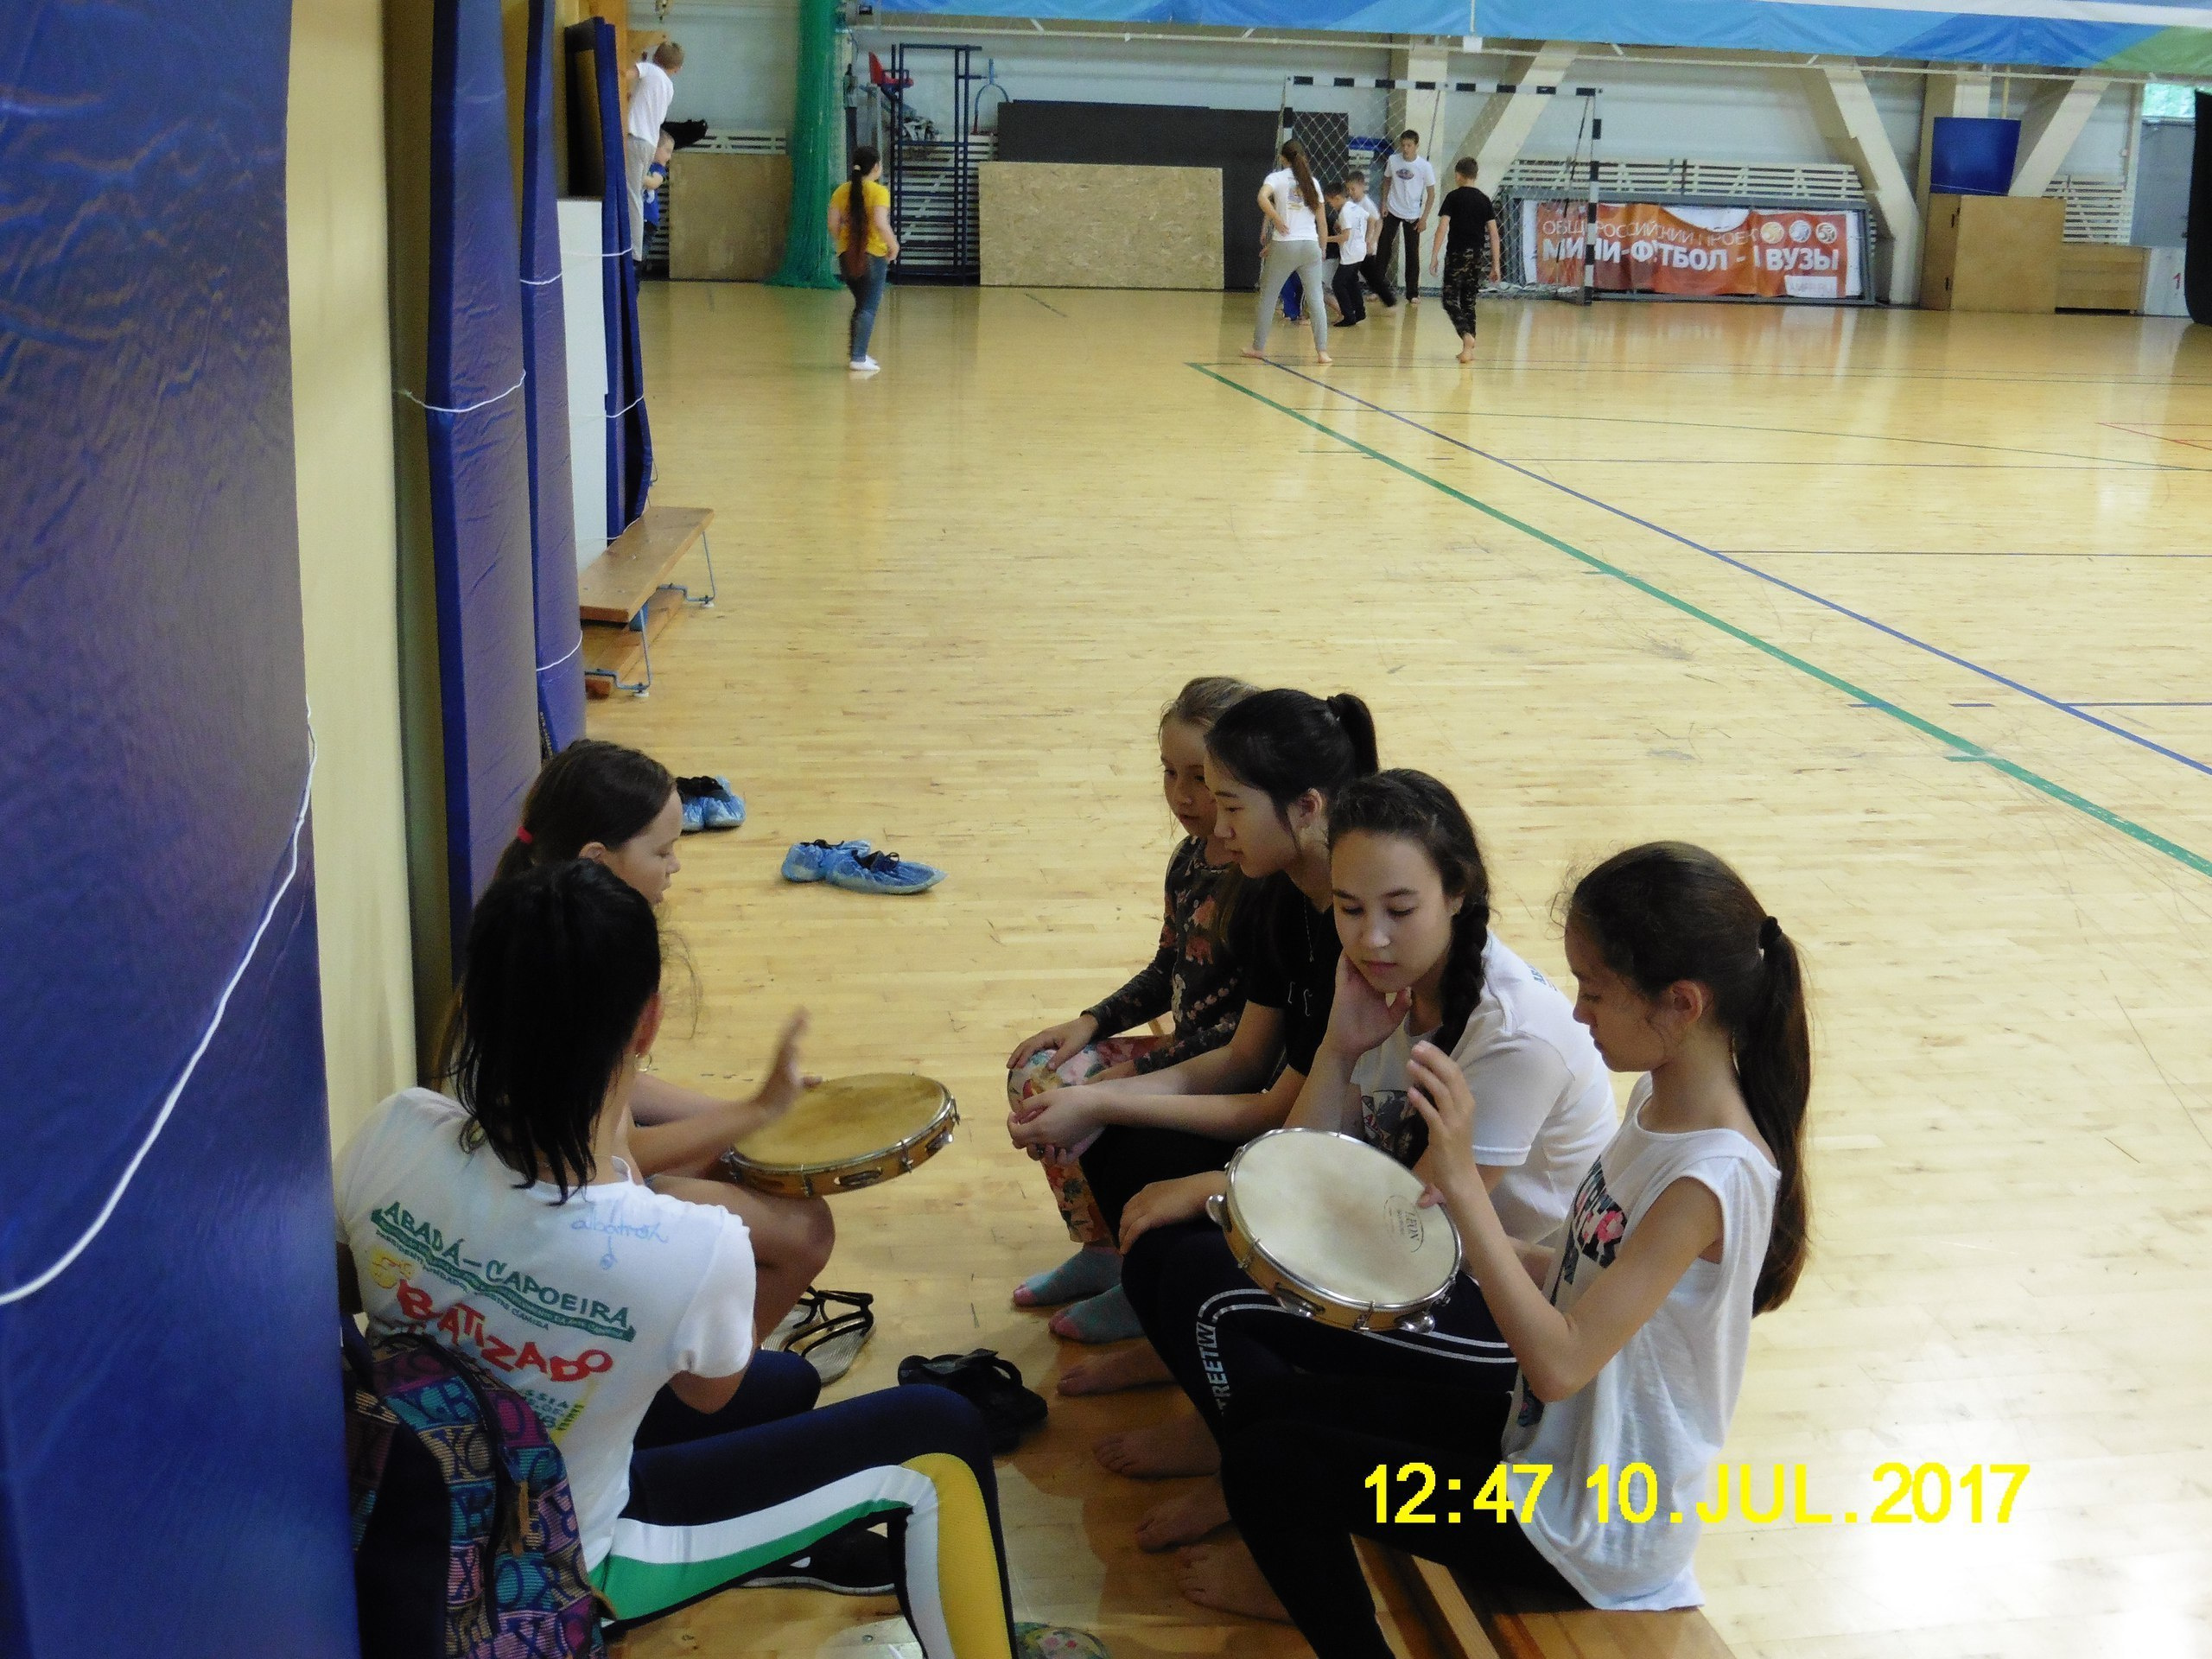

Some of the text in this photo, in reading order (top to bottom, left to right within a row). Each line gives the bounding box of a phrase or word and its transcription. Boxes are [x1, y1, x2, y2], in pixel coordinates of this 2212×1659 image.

[1542, 237, 1727, 271] МИИ-ФТБОЛ
[1765, 247, 1840, 271] ВУЗЫ
[397, 1279, 613, 1382] BATIZADO
